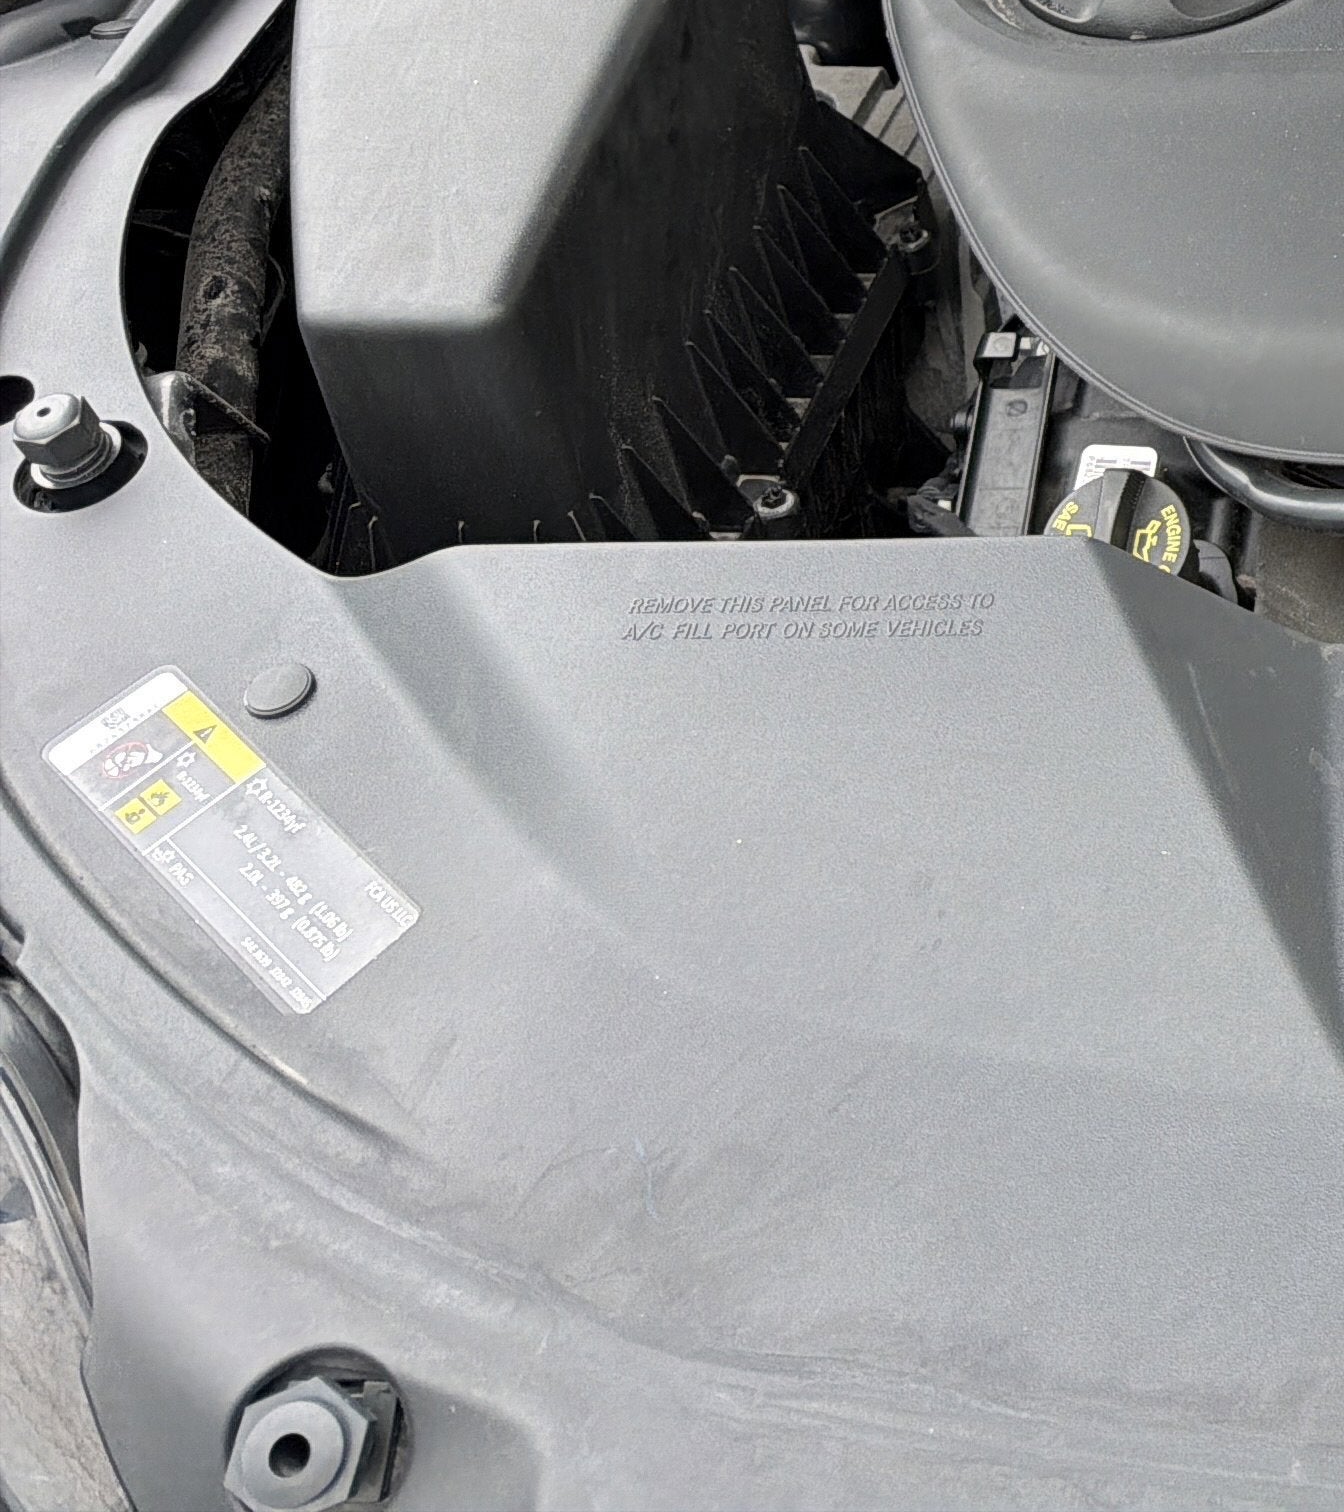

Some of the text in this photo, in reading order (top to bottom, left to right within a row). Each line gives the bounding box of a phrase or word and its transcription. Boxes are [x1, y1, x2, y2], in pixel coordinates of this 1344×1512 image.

[1052, 501, 1080, 531] SAE
[1160, 504, 1182, 563] ENGINE
[627, 593, 995, 614] REMOVE THIS PANEL FOR ACCESS TO
[622, 619, 984, 641] A/C FILL PORT ON SOME VEHICLES
